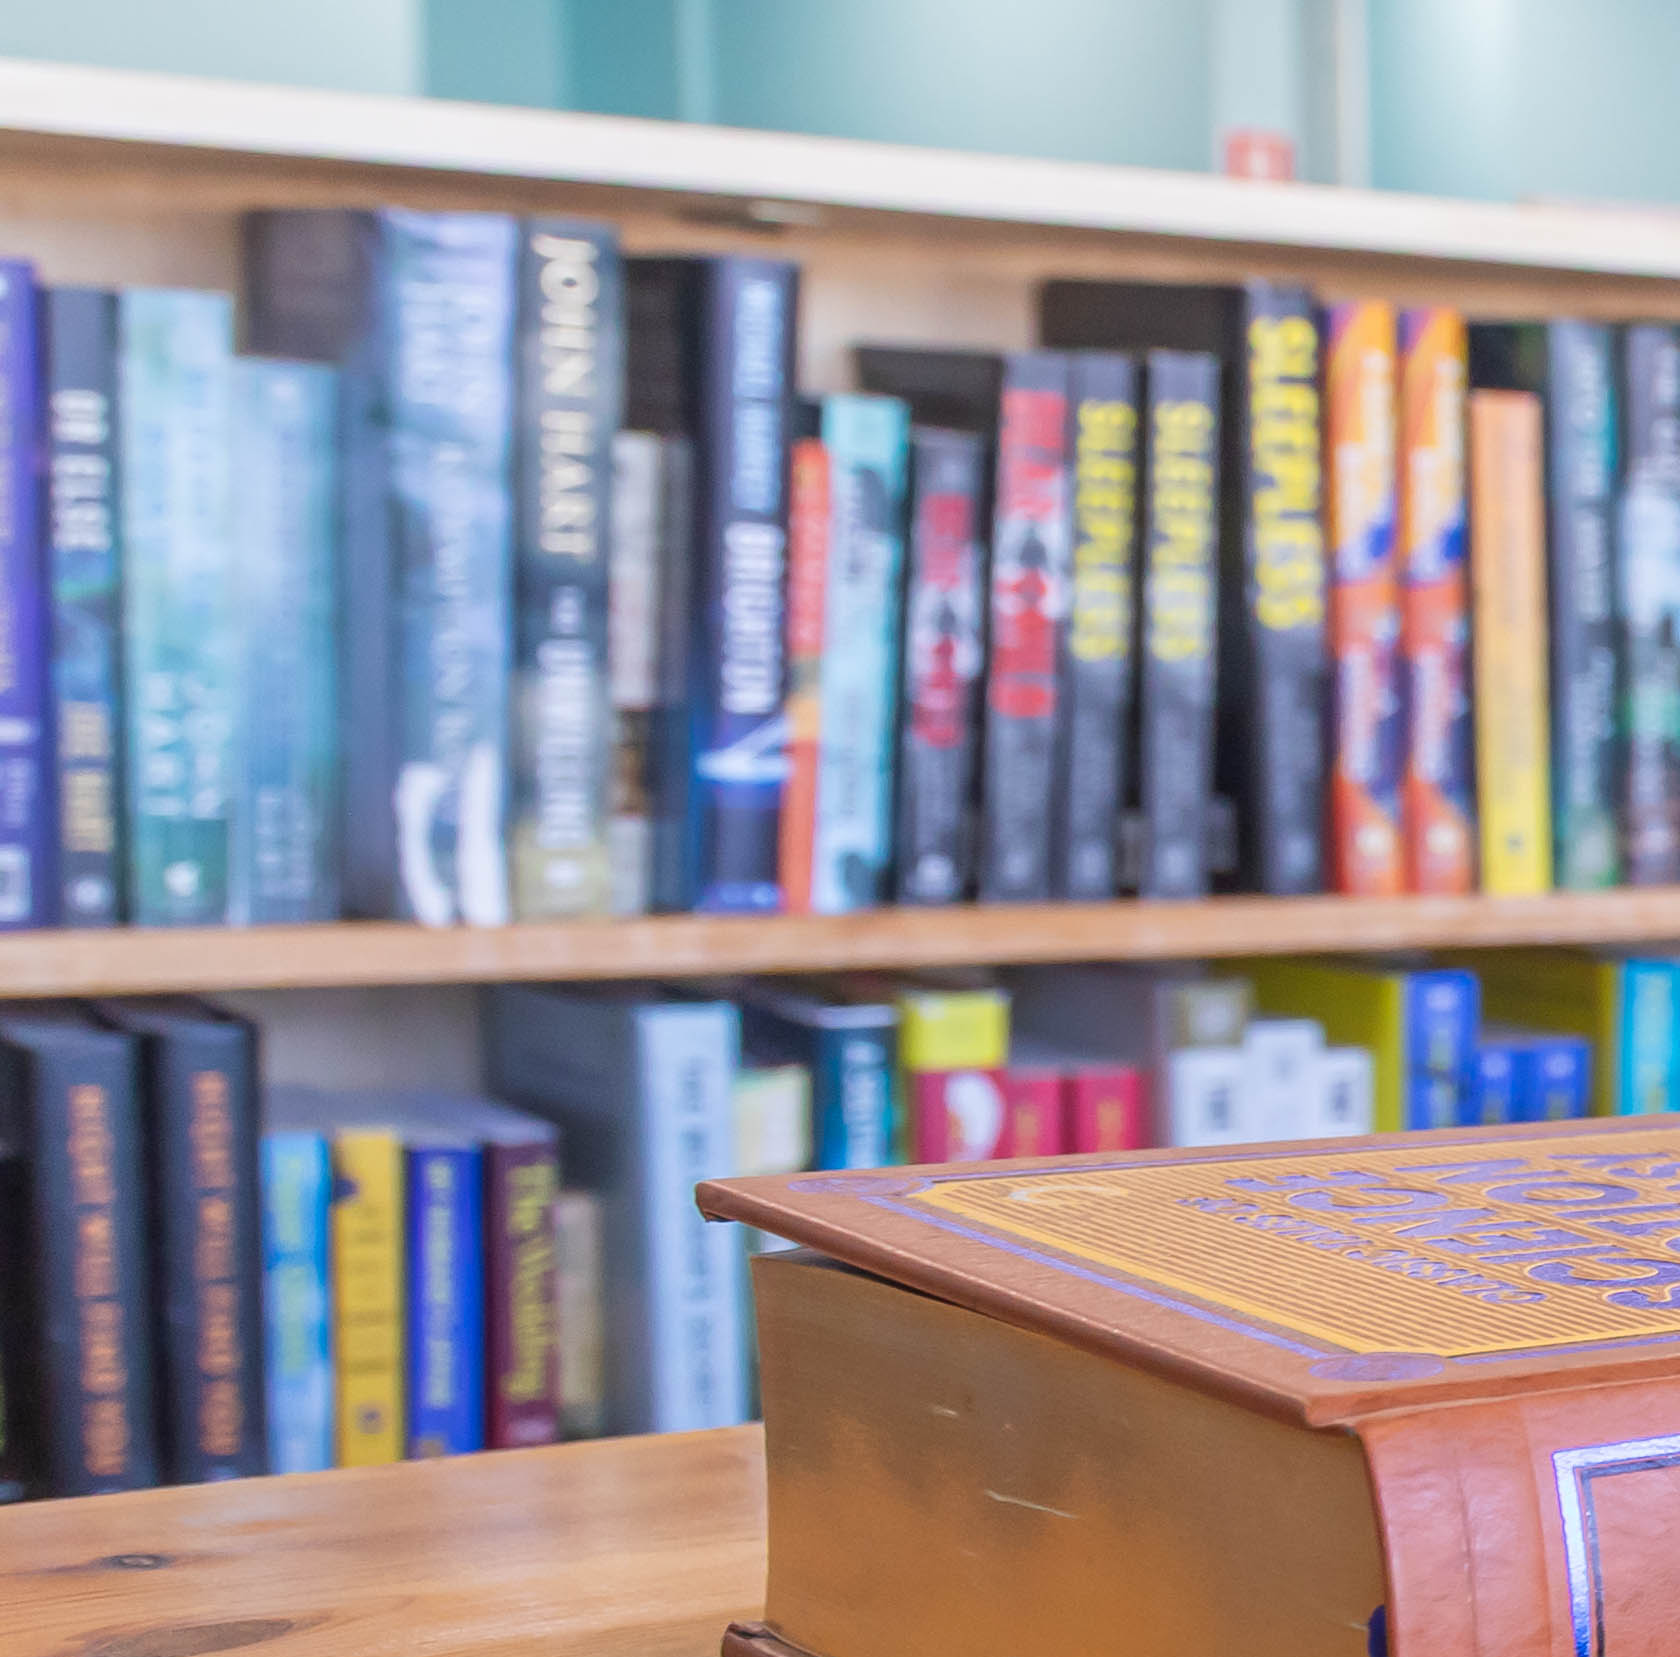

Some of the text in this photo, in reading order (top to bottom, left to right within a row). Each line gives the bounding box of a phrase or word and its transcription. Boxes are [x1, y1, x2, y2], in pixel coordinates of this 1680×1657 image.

[532, 234, 595, 560] JOHN HART
[1247, 316, 1325, 631] SLEEPLESS
